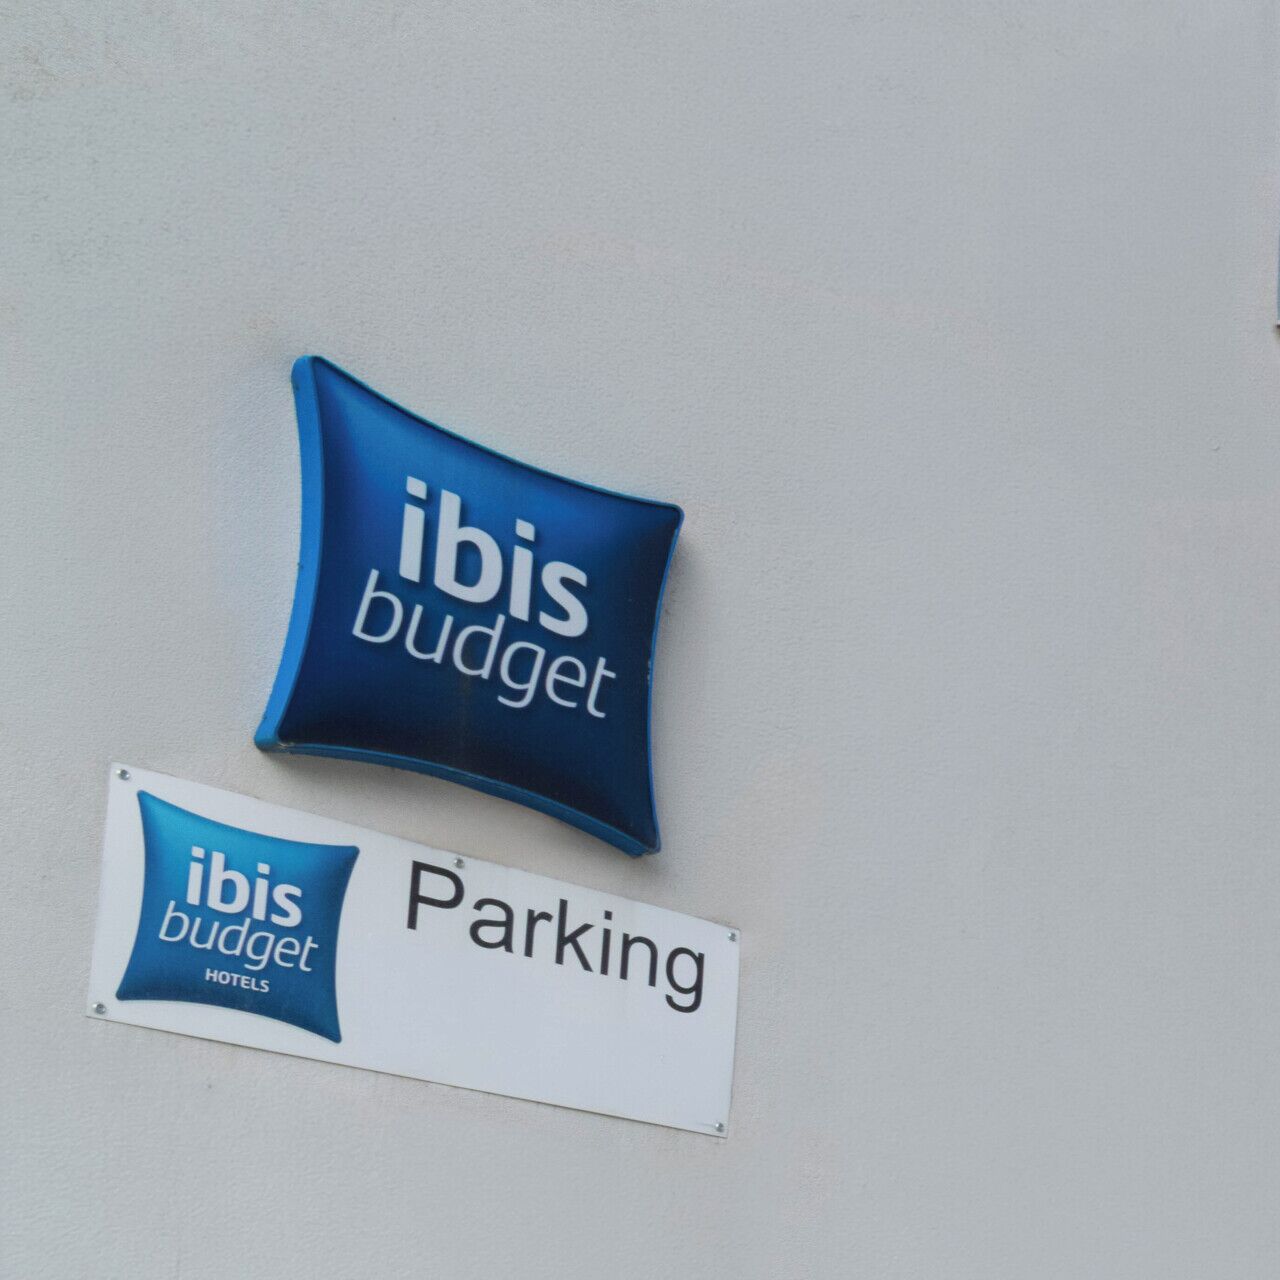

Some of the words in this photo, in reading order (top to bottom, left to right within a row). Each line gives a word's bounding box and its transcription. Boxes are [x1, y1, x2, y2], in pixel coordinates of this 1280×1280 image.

[399, 475, 589, 638] ibis
[352, 568, 616, 718] budget
[158, 900, 319, 972] budget
[186, 845, 302, 927] ibis
[406, 860, 705, 1013] Parking
[204, 968, 270, 993] HOTELS
